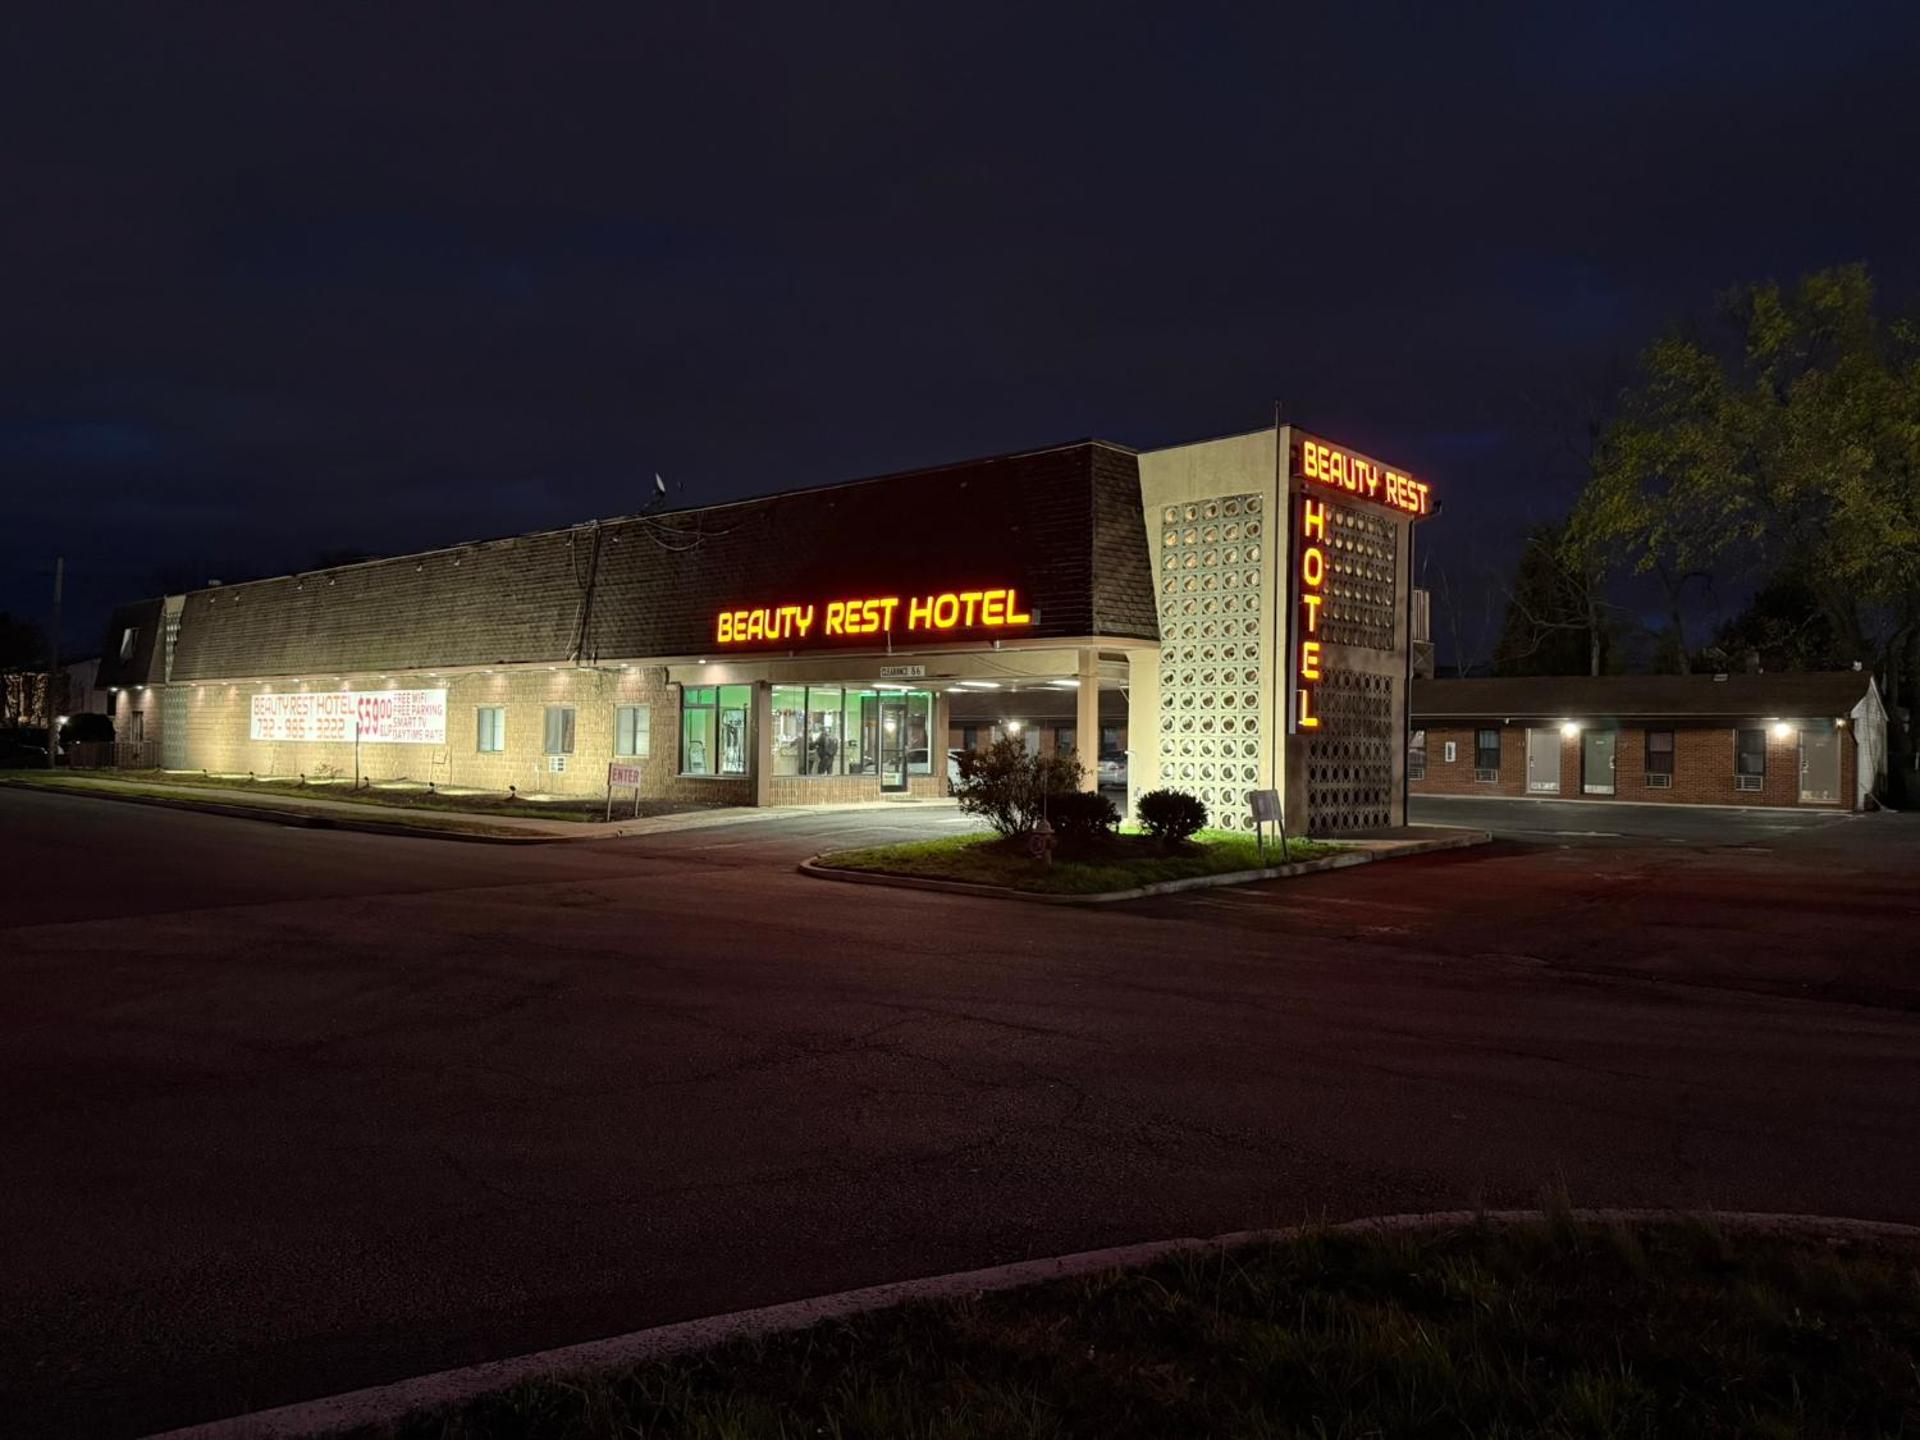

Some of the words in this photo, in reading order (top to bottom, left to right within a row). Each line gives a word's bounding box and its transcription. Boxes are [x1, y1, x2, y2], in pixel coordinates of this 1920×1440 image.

[1303, 440, 1377, 497] BEAUTY
[1385, 471, 1429, 514] REST
[717, 605, 813, 643] BEAUTY
[826, 598, 898, 635] REST
[908, 589, 1029, 630] HOTEL
[1299, 499, 1325, 727] HOTEL
[317, 694, 355, 715] HOTEL
[393, 692, 410, 704] FREE
[393, 704, 410, 716] FREE
[411, 703, 443, 716] PARKING
[393, 716, 416, 728] SMART
[418, 716, 428, 728] TV
[392, 729, 423, 741] DAYTIME
[425, 729, 444, 741] RATE
[612, 767, 640, 784] ENTER
